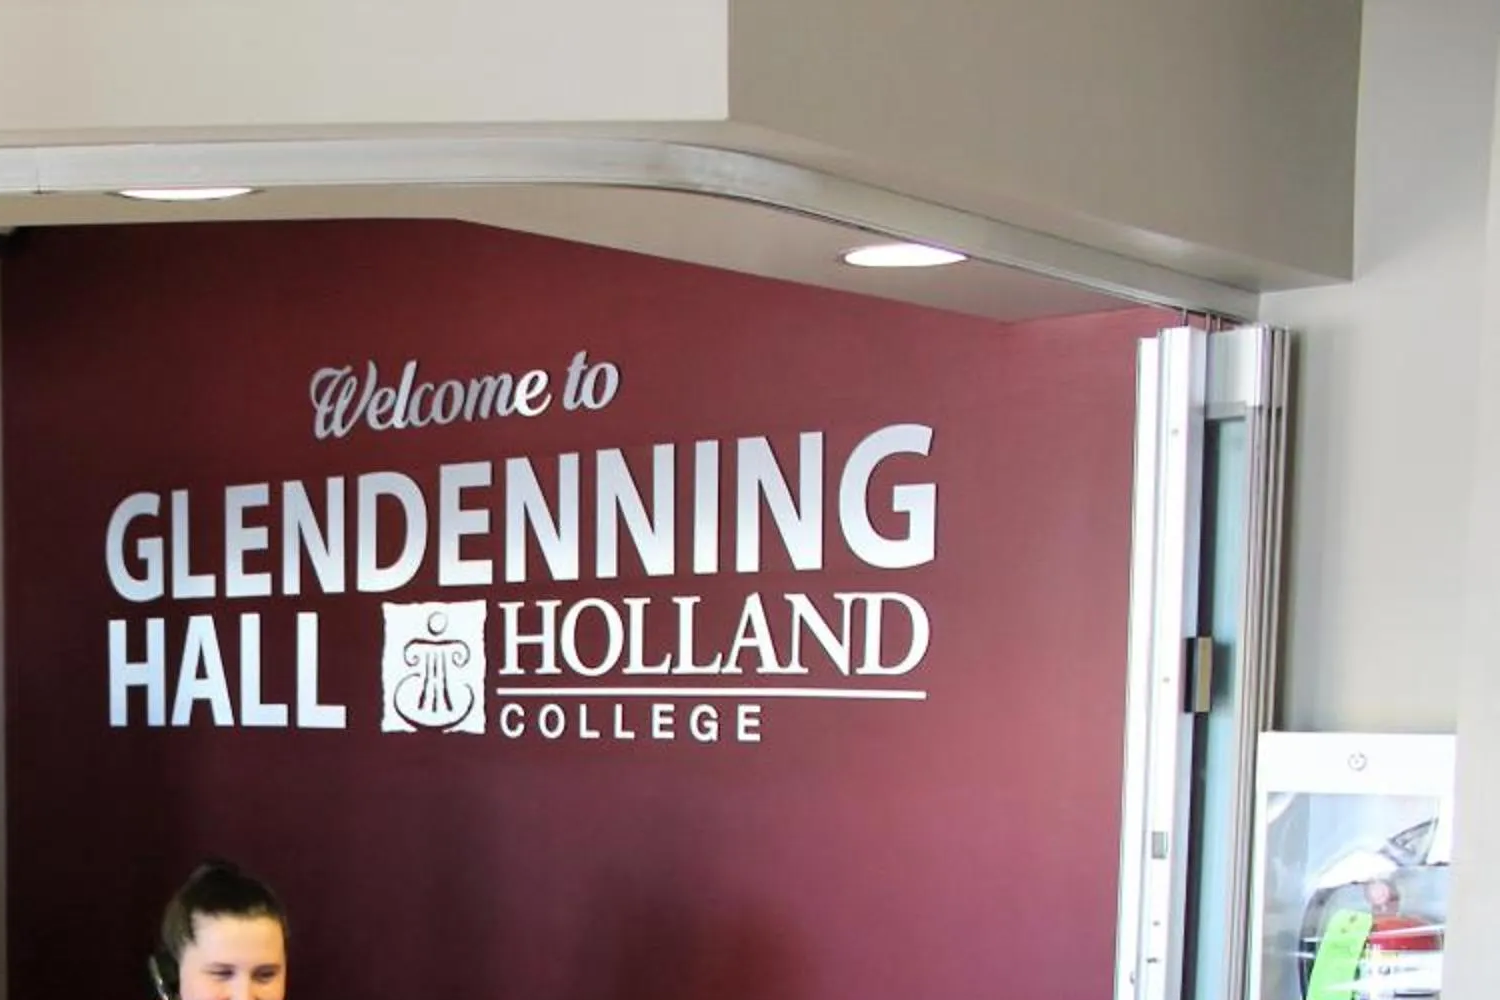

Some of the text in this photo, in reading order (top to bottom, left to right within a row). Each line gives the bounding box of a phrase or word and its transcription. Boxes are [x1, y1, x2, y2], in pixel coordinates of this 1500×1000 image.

[310, 350, 620, 439] Welcome to
[106, 423, 937, 602] GLENDENNING
[108, 611, 347, 729] HALL
[497, 591, 931, 677] HOLLAND
[499, 702, 762, 743] COLLEGE
